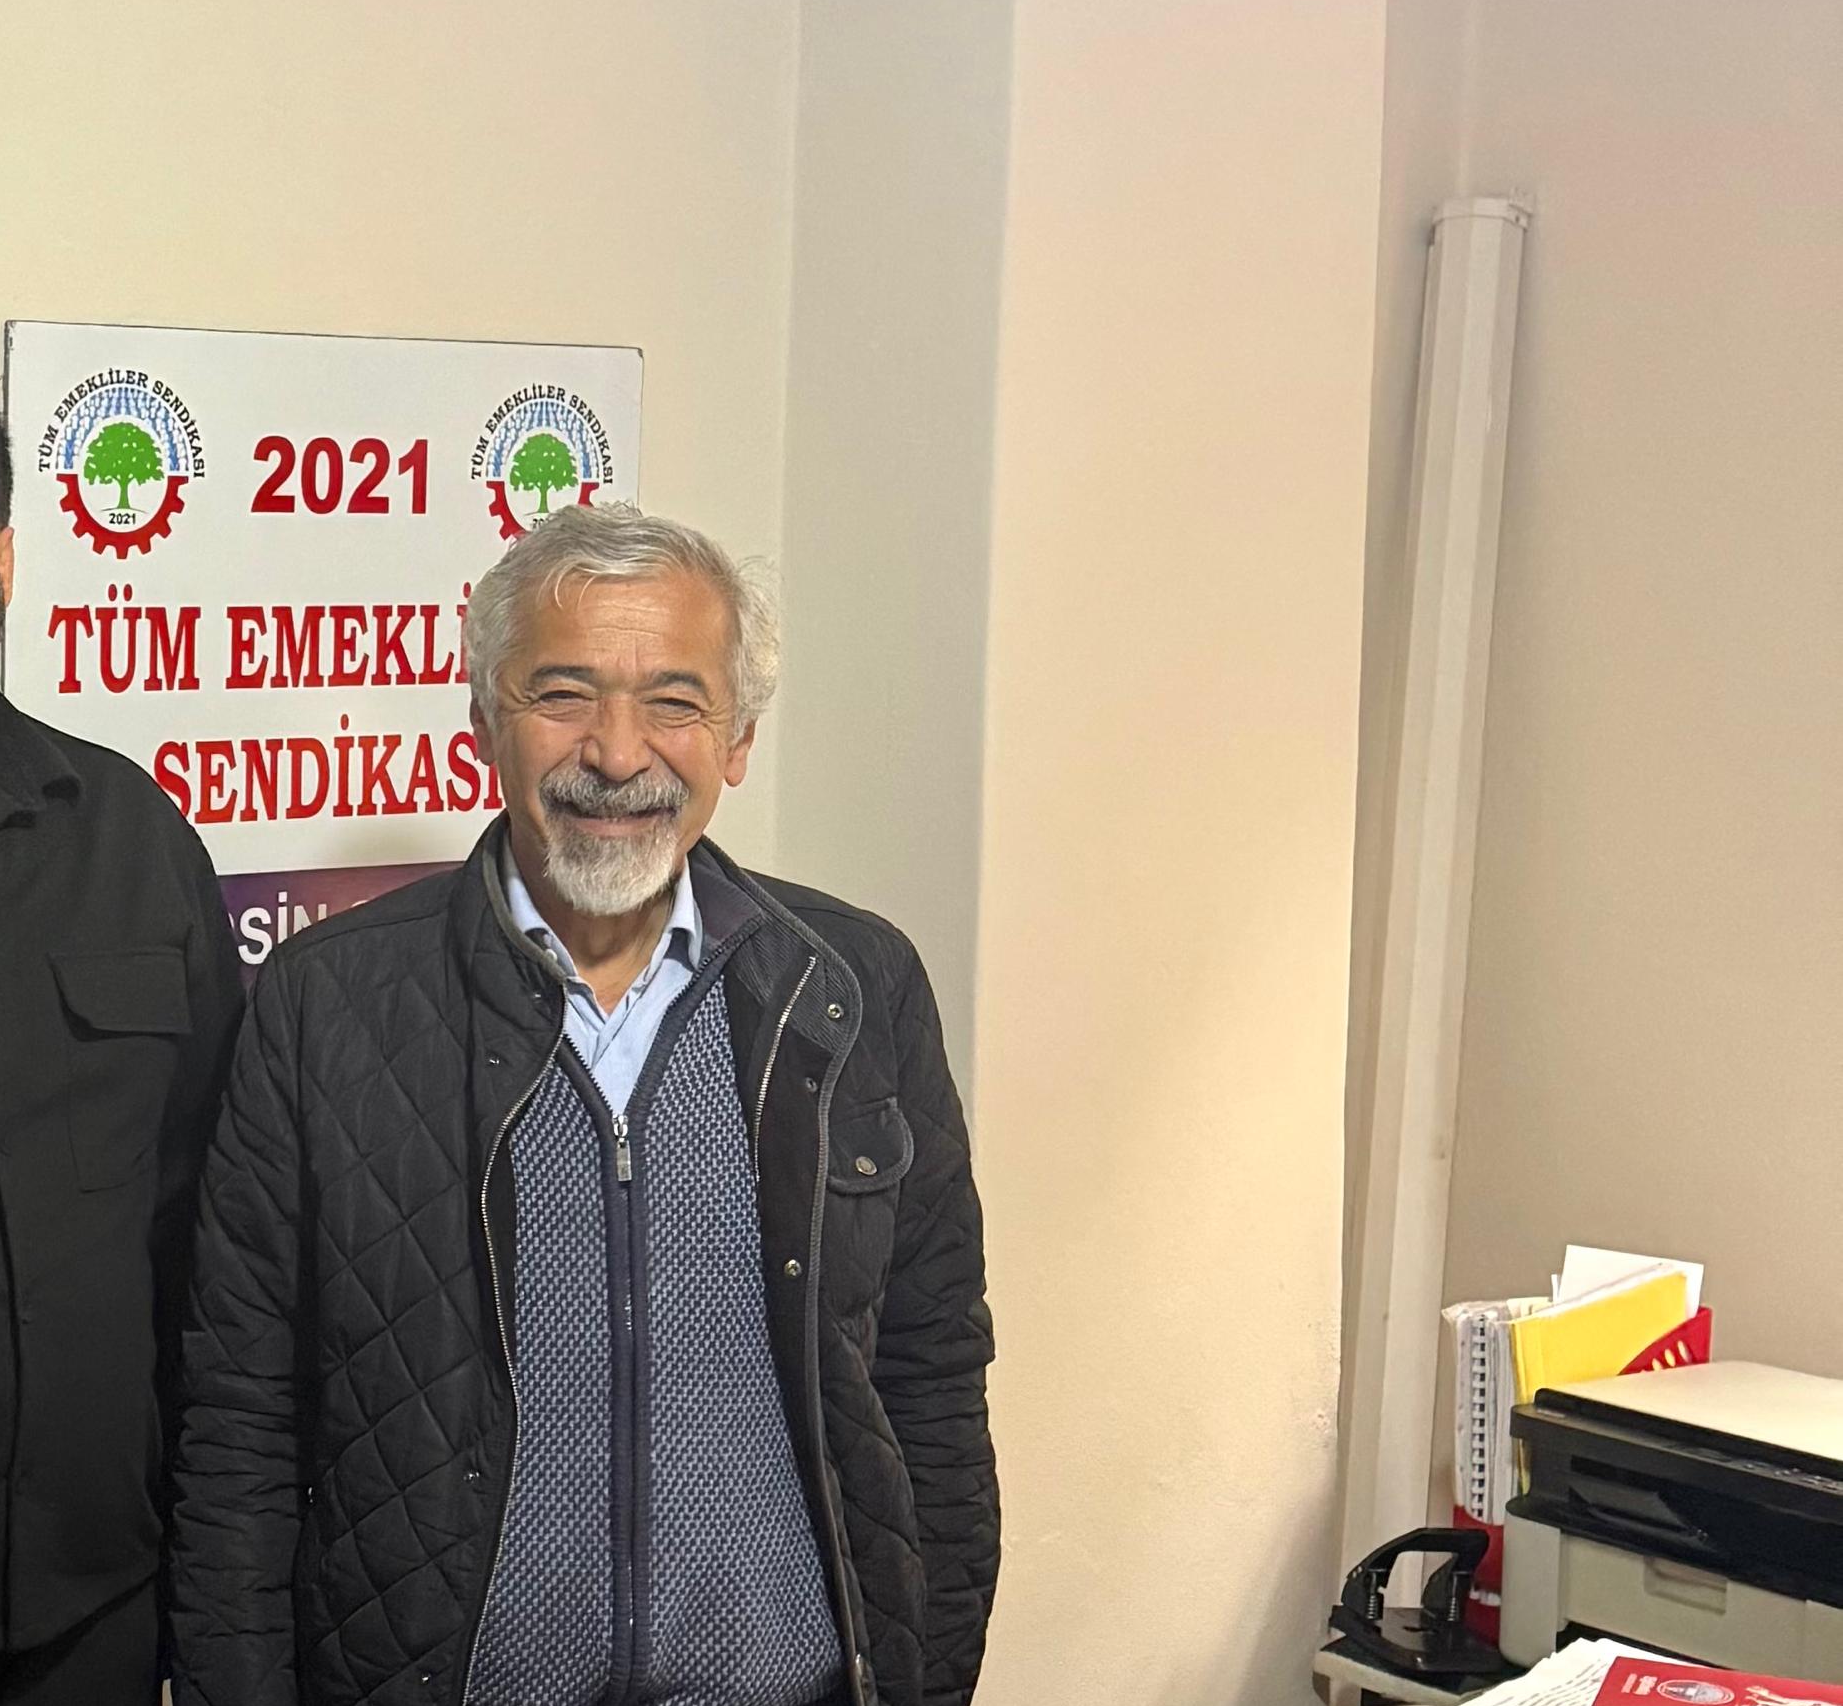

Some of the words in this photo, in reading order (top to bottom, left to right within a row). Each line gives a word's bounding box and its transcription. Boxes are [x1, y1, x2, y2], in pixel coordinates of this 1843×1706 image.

[38, 425, 58, 472] TÜM
[54, 368, 149, 422] EMEKLİLER
[152, 380, 205, 478] SENDİKASI
[251, 436, 428, 514] 2021
[471, 436, 489, 479] TÜM
[485, 383, 566, 434] EMEKLİLER
[569, 395, 613, 484] SENDİKASI
[109, 513, 136, 524] 2021
[48, 584, 200, 693] TÜM
[153, 714, 503, 824] SENDİKASI
